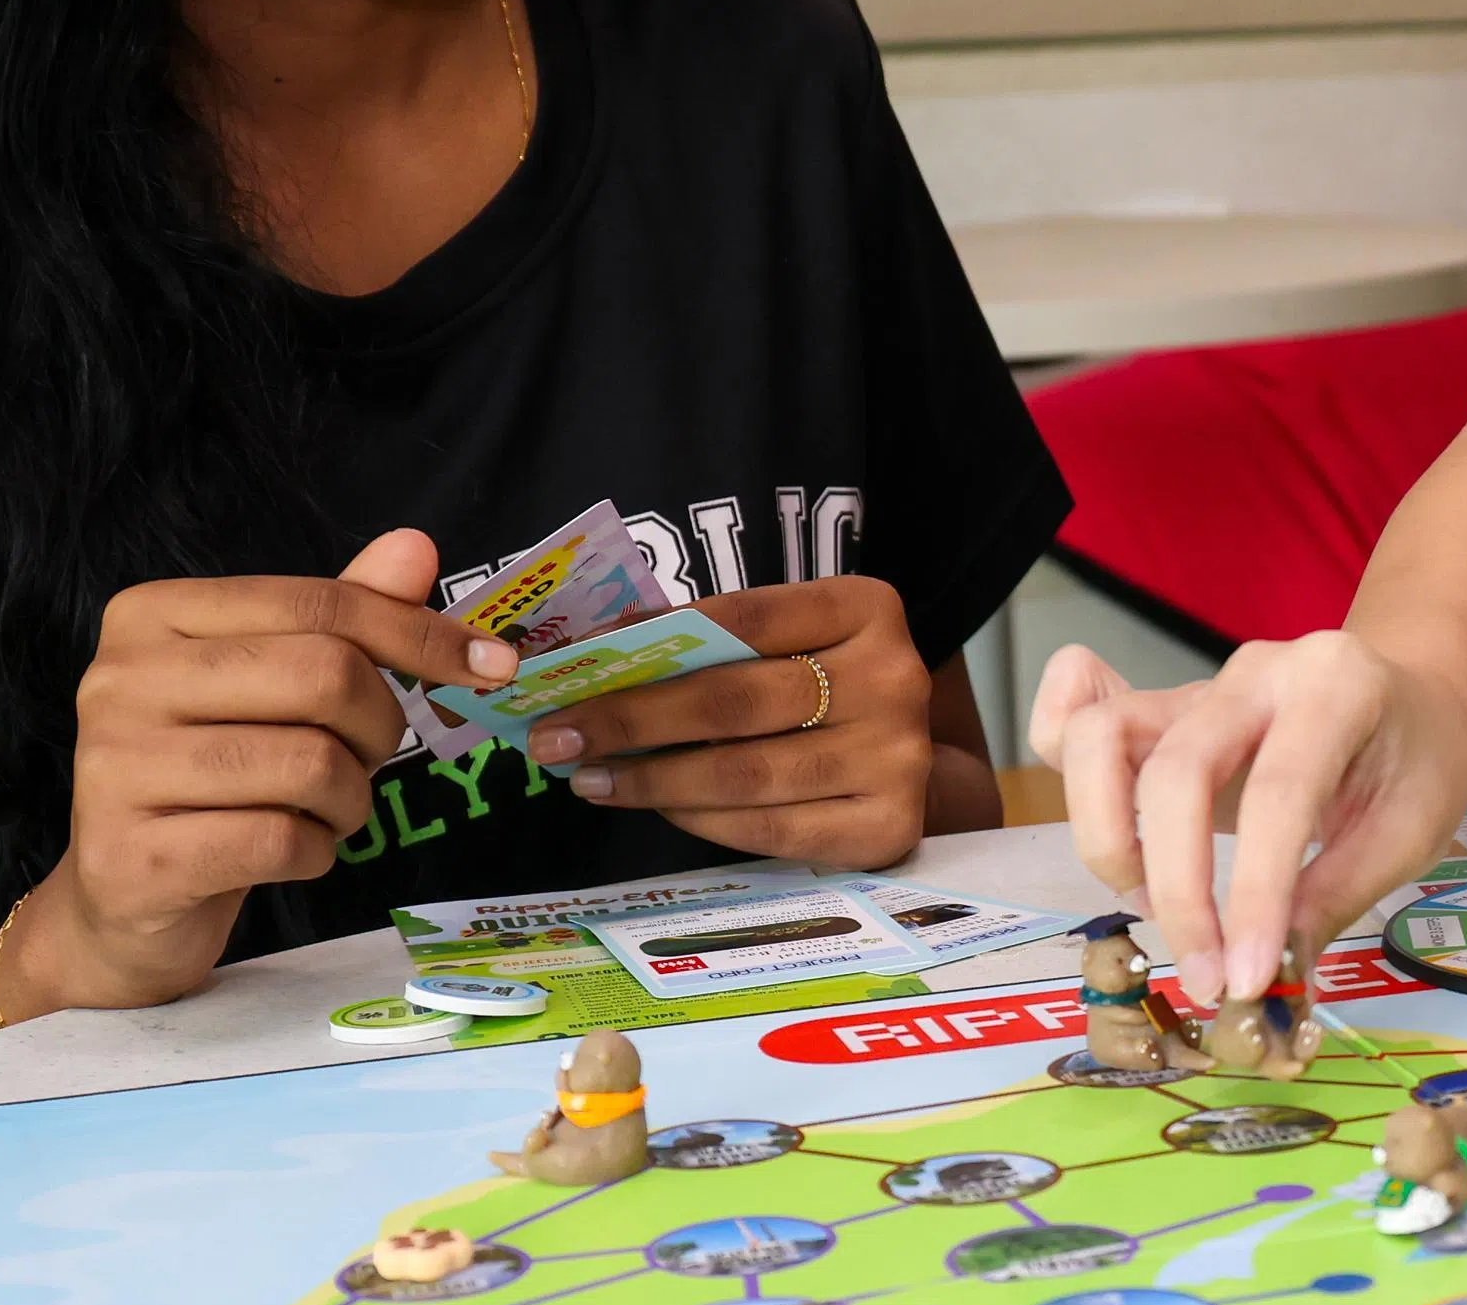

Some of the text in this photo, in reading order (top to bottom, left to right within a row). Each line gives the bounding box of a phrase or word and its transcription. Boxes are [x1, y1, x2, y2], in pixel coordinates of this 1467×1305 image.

[490, 579, 556, 630] ARD
[508, 639, 682, 711] PROJECT
[539, 658, 599, 681] SDG
[476, 896, 618, 915] Ripple
[622, 883, 750, 903] Effect
[778, 944, 859, 960] National
[780, 939, 853, 954] Security
[549, 972, 583, 981] TURN
[709, 953, 862, 980] PROJECT CARD
[568, 1016, 637, 1030] RESOURCE
